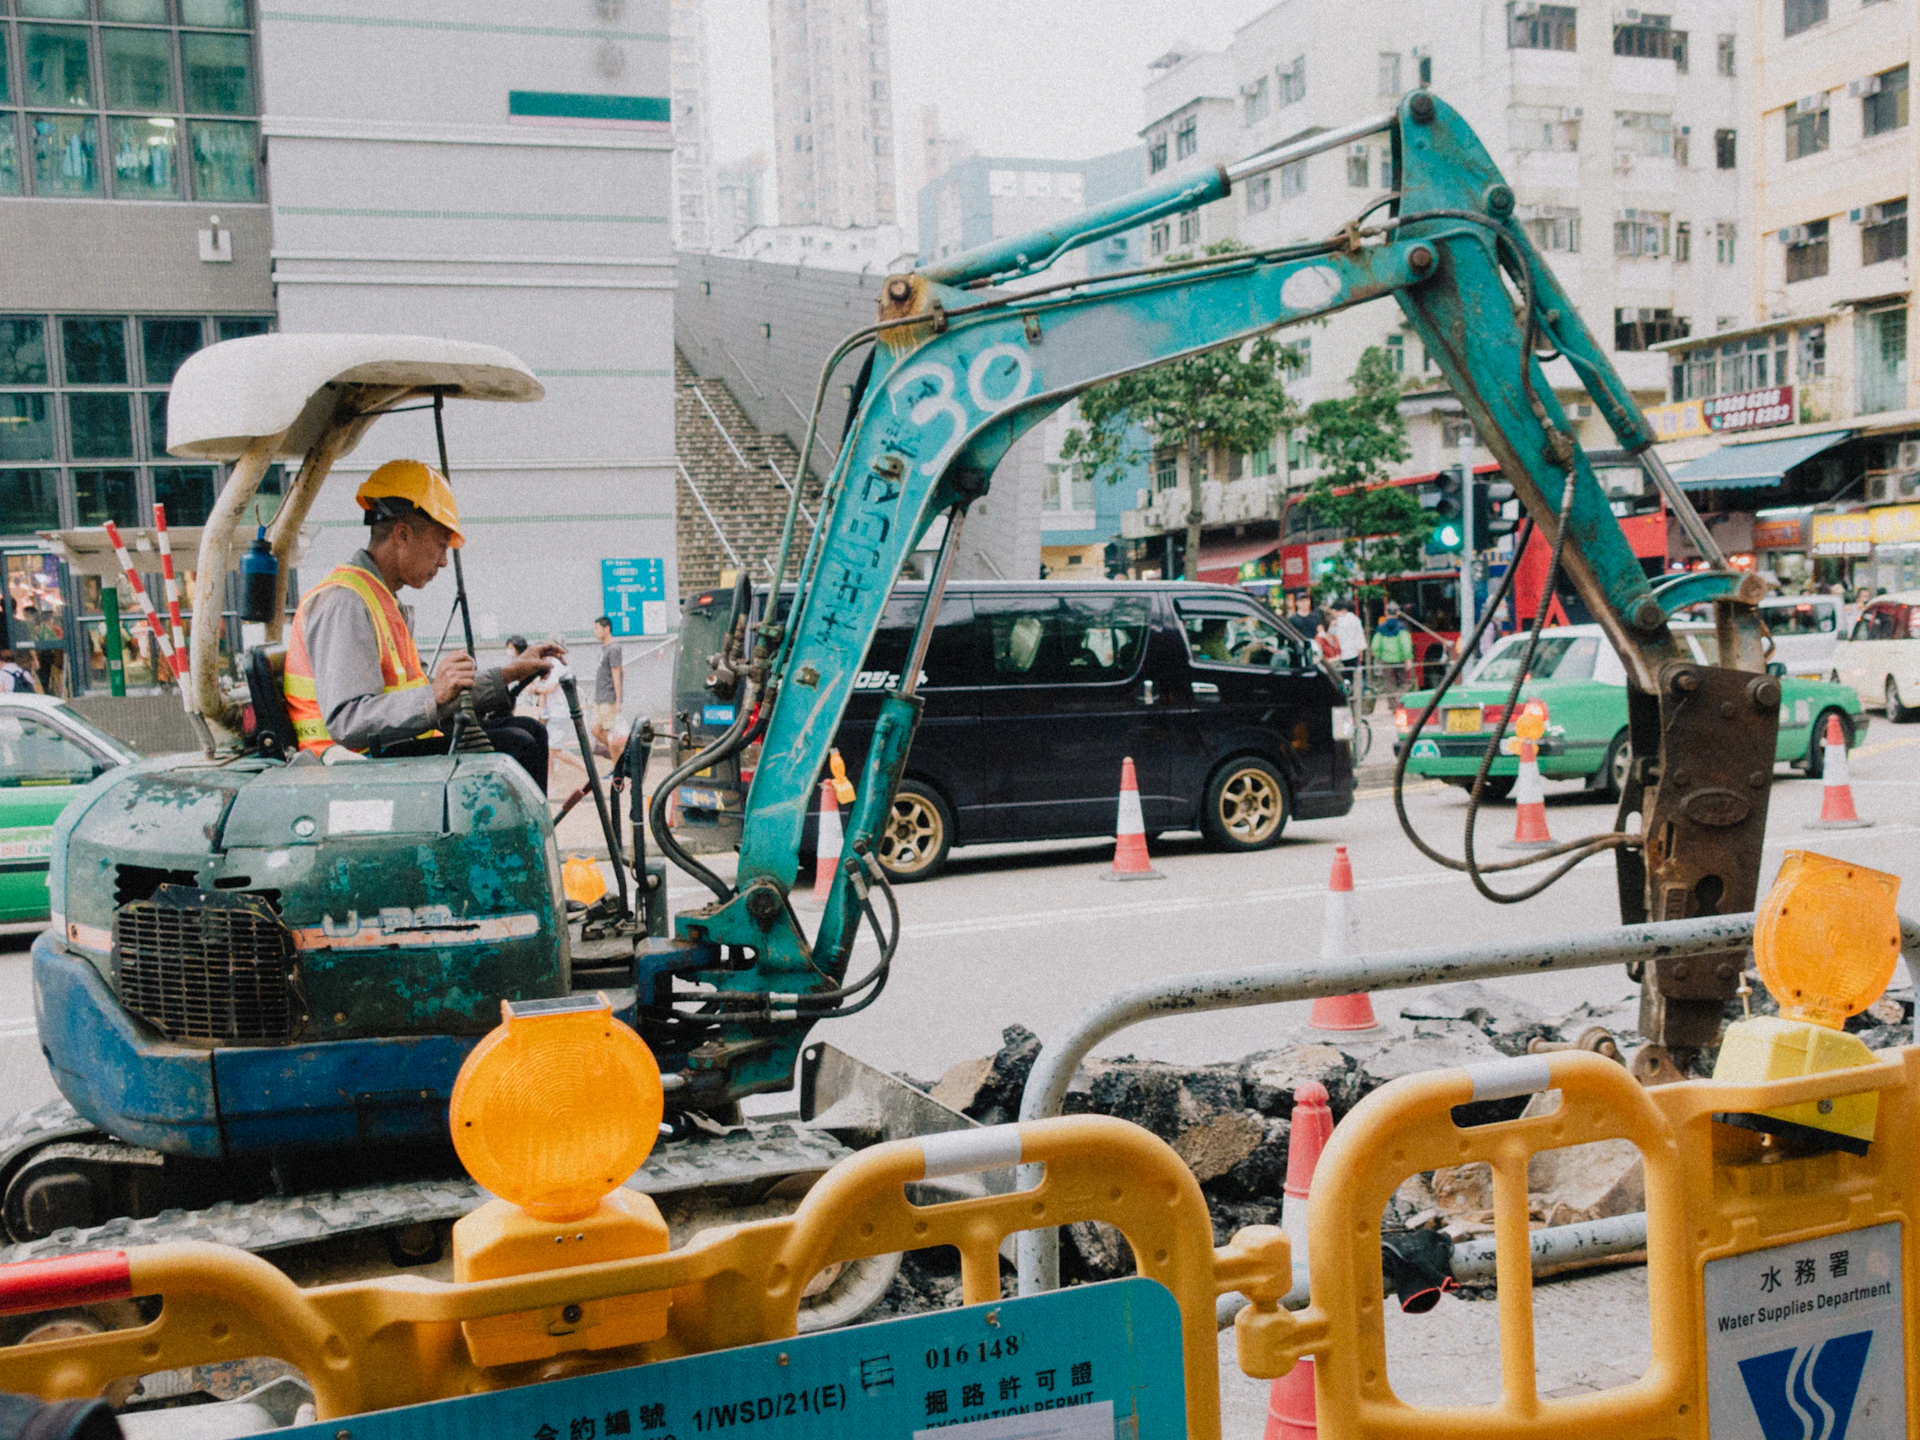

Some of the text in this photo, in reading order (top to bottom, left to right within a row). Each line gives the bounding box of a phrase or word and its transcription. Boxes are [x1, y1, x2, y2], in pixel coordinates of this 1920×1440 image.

[887, 343, 1032, 475] 30
[1760, 1250, 1850, 1293] 水務署
[1718, 1281, 1892, 1332] Water Supplies Department
[692, 1383, 846, 1432] 1/WSD/21(E)
[925, 1361, 1093, 1416] 掘路許可證
[1034, 1391, 1094, 1412] PERMIT
